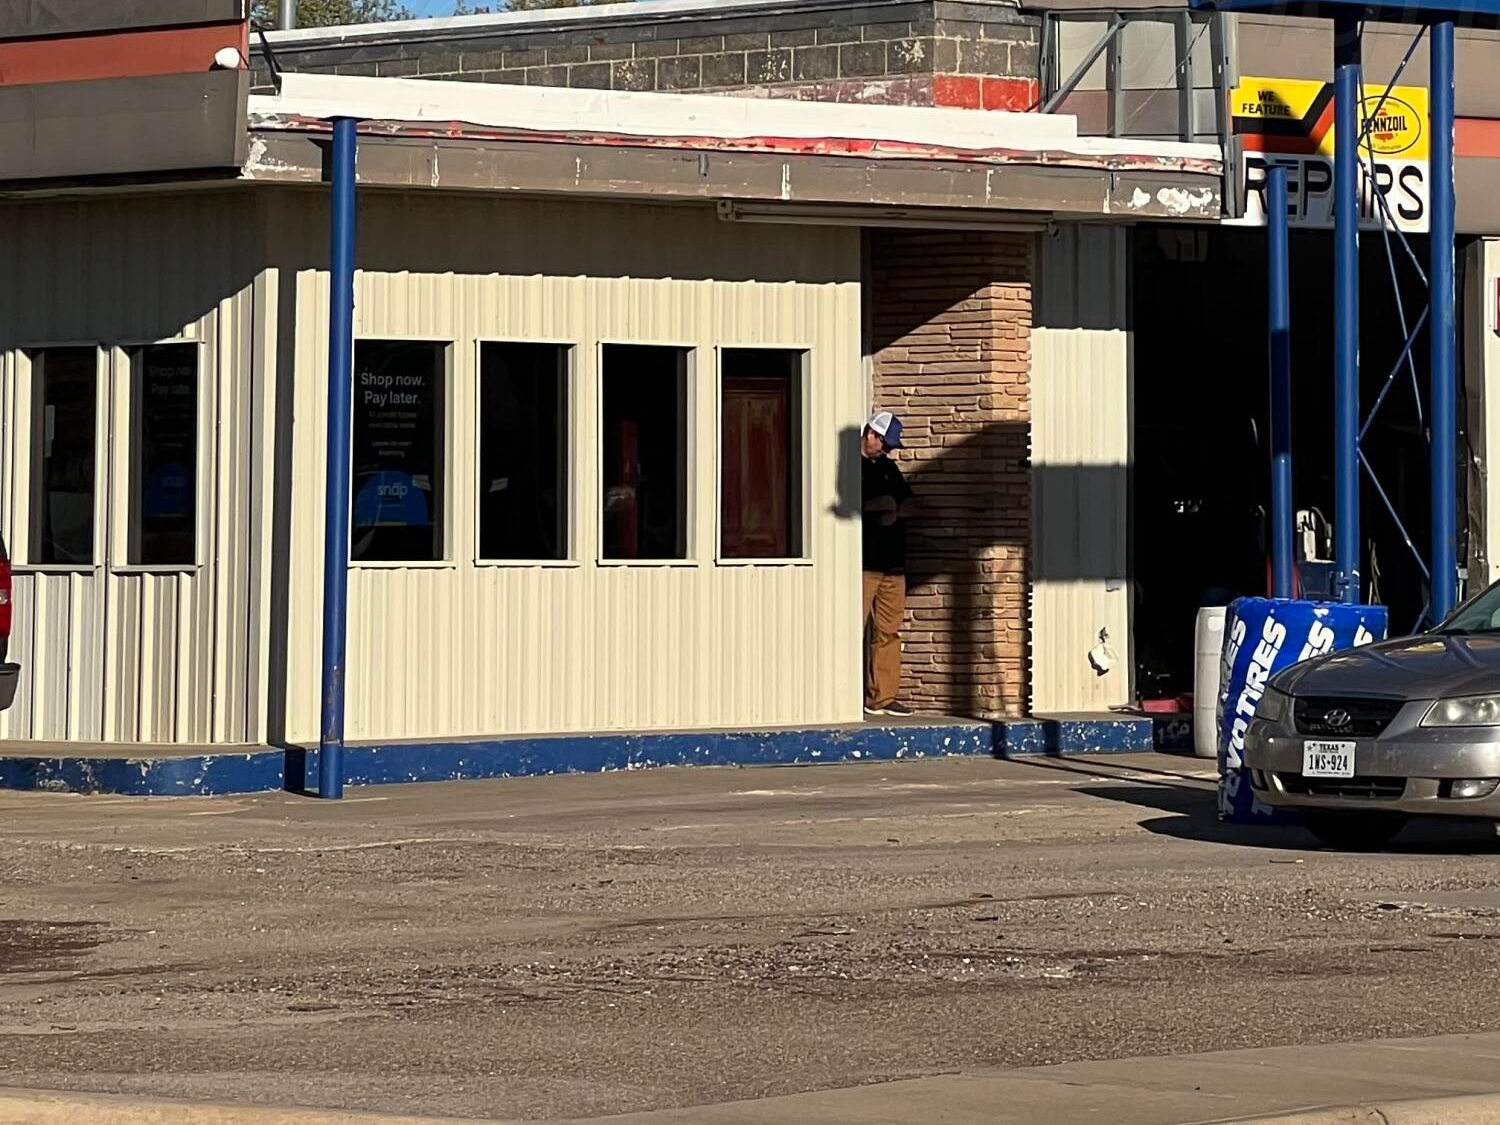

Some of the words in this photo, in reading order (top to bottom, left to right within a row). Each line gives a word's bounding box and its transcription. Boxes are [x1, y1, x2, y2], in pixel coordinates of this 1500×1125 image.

[1258, 90, 1275, 102] WE
[1242, 103, 1291, 116] FEATURE
[1244, 157, 1424, 221] REPIRS
[361, 372, 393, 389] Shop
[395, 375, 426, 386] now.
[364, 390, 387, 407] Pay
[390, 390, 421, 404] later.
[1319, 743, 1339, 751] TEXAS
